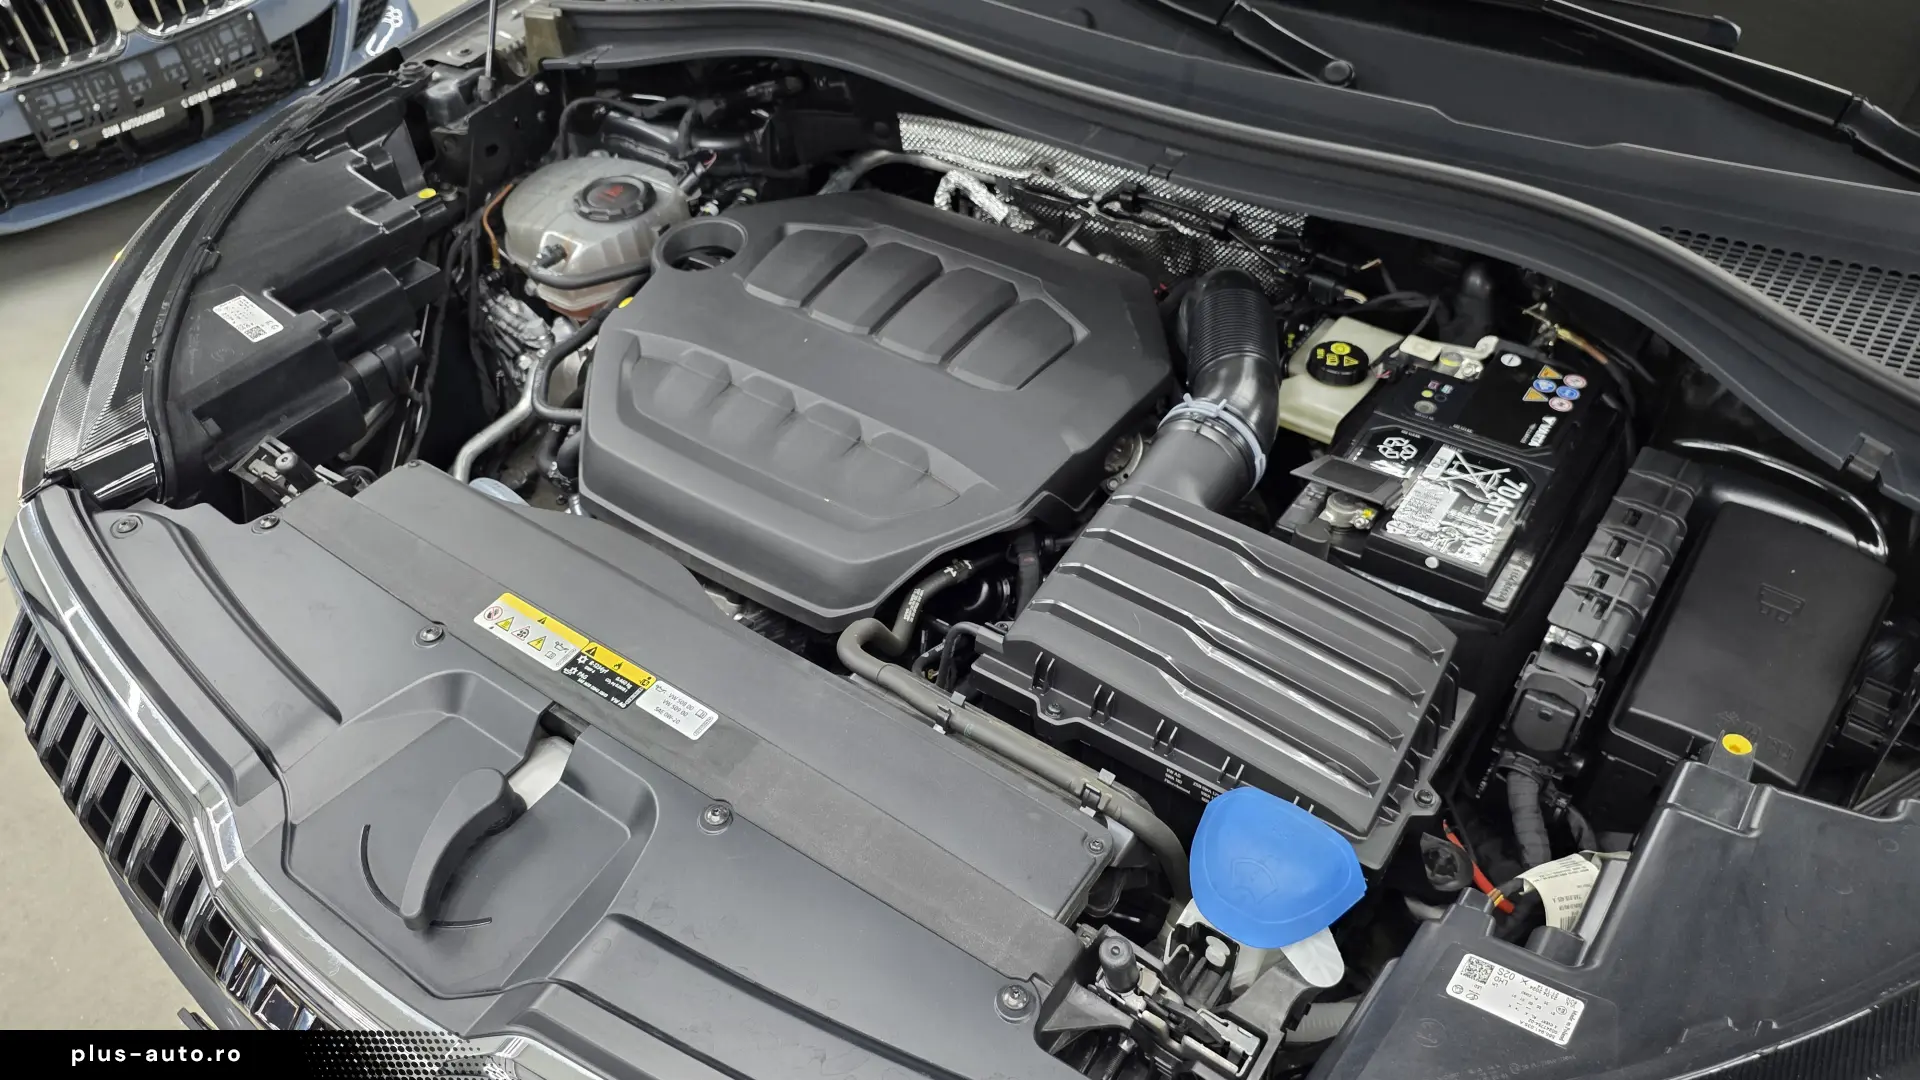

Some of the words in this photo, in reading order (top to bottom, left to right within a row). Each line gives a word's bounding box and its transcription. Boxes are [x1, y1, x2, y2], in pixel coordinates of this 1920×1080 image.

[1431, 455, 1447, 470] Pb
[668, 692, 679, 701] VW
[662, 698, 673, 707] VW
[1496, 967, 1516, 981] 02S
